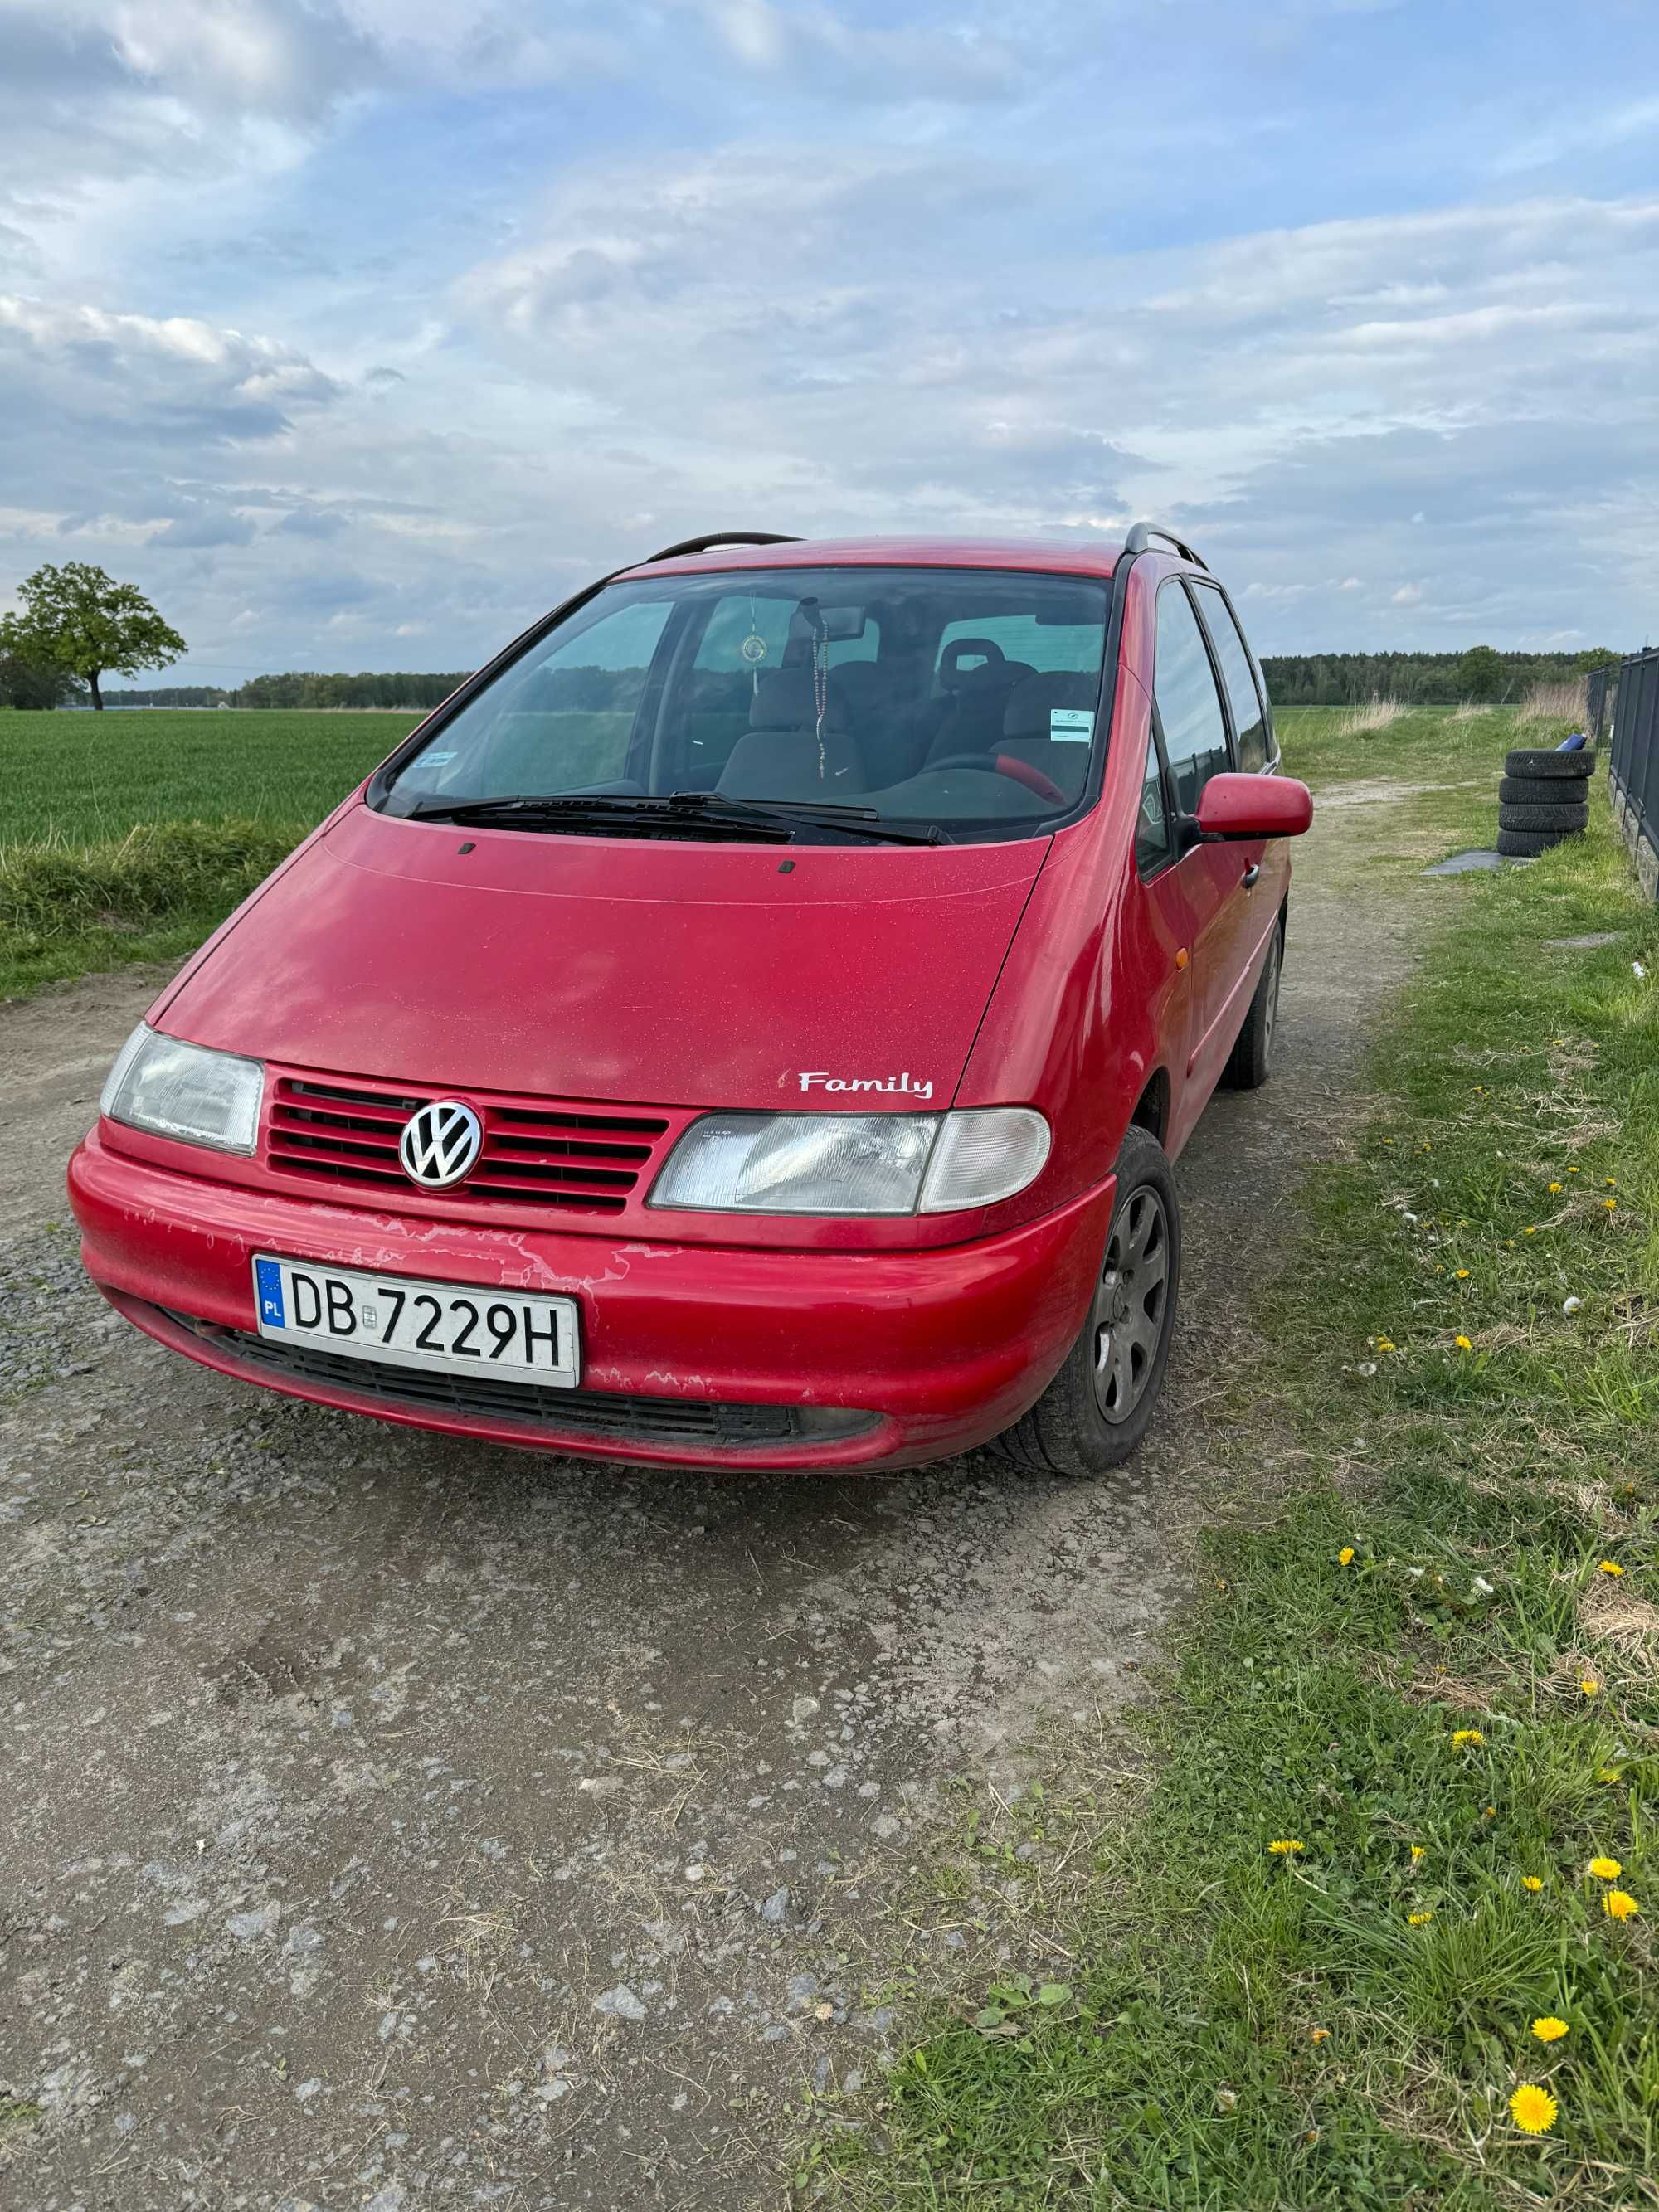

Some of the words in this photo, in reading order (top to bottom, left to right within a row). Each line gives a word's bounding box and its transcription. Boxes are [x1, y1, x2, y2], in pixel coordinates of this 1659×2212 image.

[798, 1072, 933, 1099] Family
[401, 1102, 479, 1184] VW
[264, 1300, 283, 1318] PL
[291, 1272, 357, 1335] DB
[377, 1287, 559, 1366] 7229H
